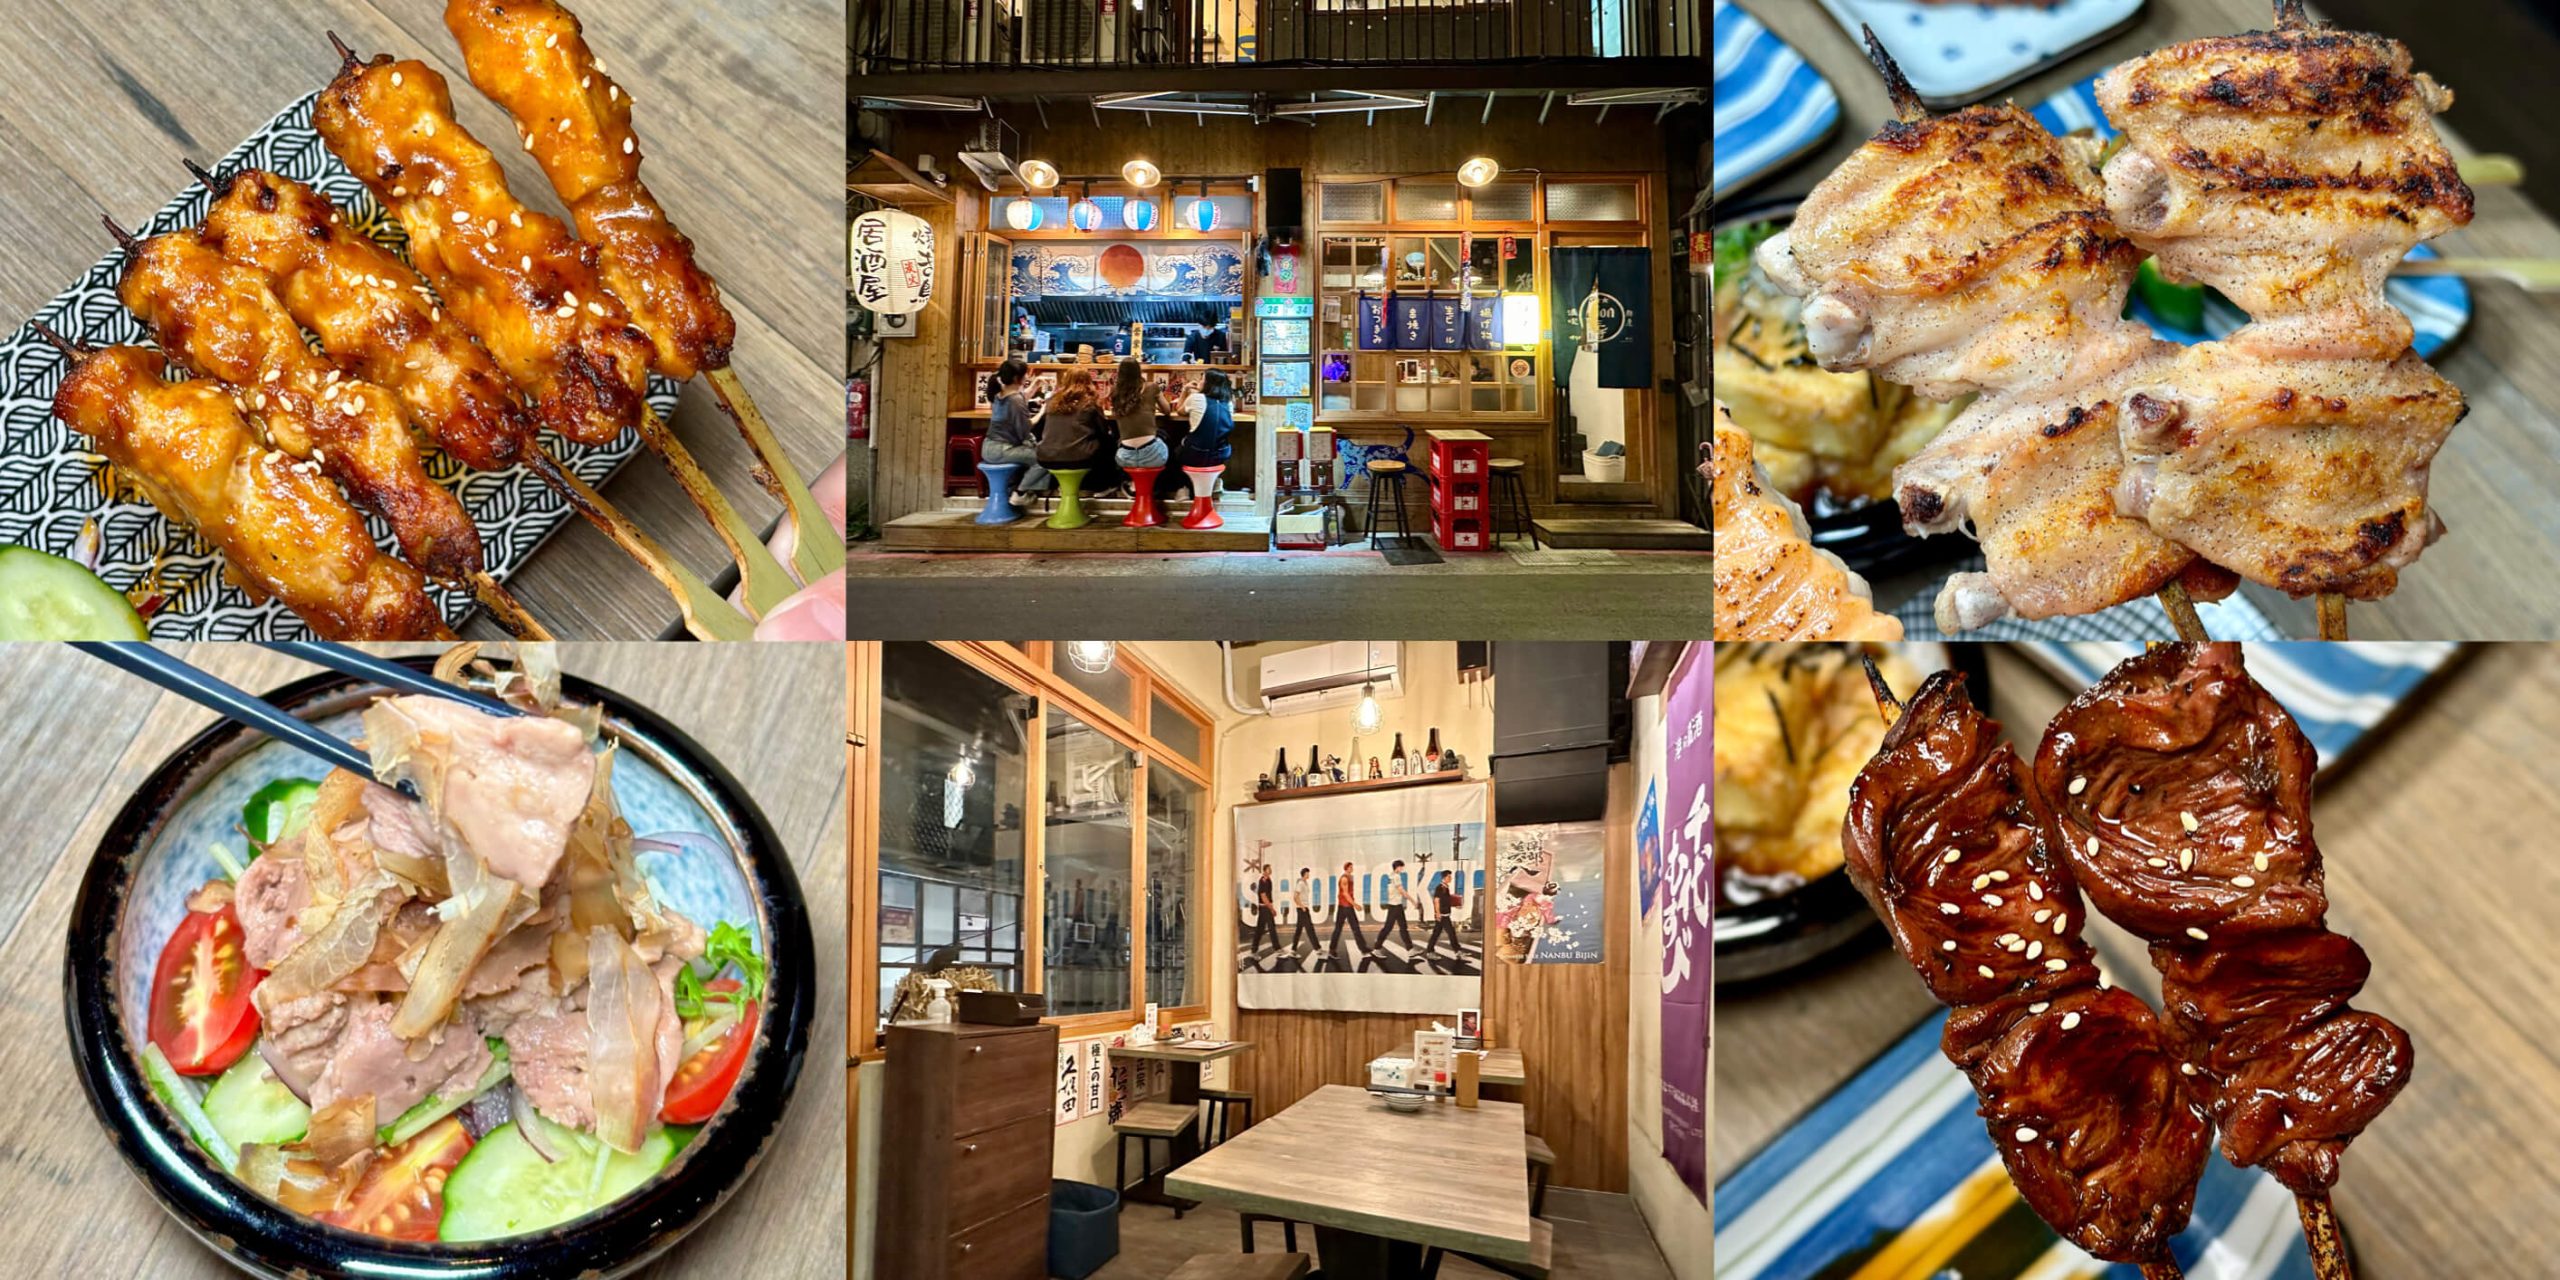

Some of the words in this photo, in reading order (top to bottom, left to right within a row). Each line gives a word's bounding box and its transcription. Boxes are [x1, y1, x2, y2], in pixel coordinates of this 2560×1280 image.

[854, 218, 889, 302] 居酒屋
[1371, 304, 1382, 344] おつまみ
[1406, 308, 1420, 341] 串焼き
[1444, 305, 1455, 344] 生ビール
[1480, 307, 1493, 340] 揚げ物
[1540, 951, 1573, 959] NANBU
[1575, 951, 1598, 960] BIJIN
[1058, 1055, 1078, 1113] 久保田
[1090, 1043, 1101, 1111] 極上の甘口
